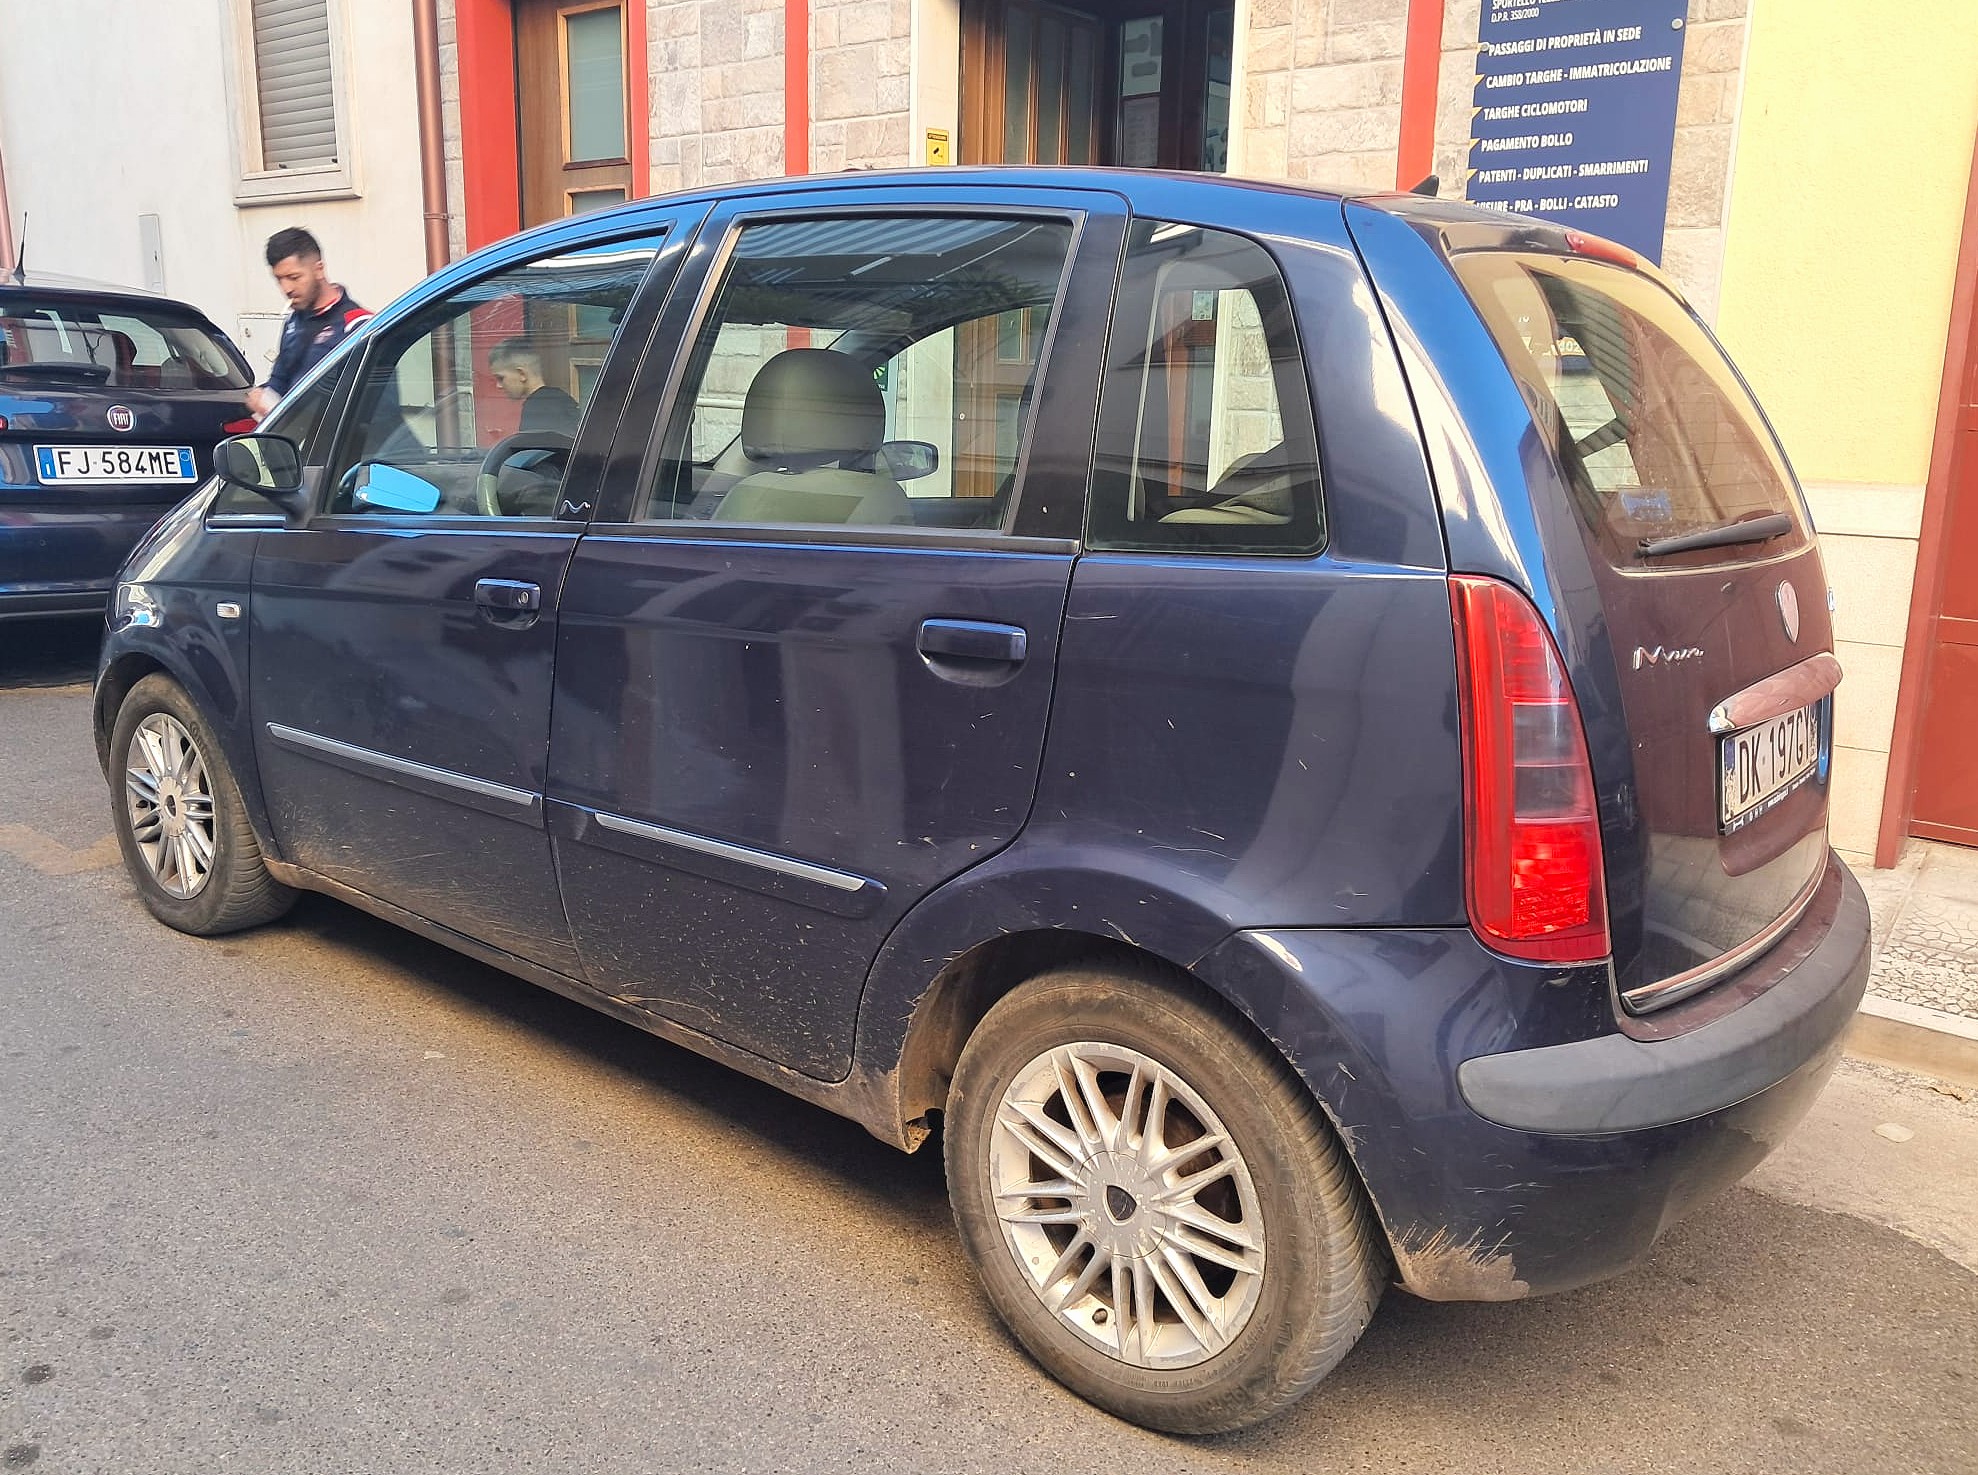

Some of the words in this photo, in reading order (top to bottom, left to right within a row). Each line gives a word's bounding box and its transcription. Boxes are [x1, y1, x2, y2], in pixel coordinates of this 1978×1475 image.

[1488, 39, 1535, 56] PASSAGGI
[1536, 36, 1547, 51] DI
[1548, 28, 1601, 50] PROPRIETÀ
[1603, 30, 1616, 43] IN
[1617, 26, 1642, 42] SEDE
[1486, 74, 1524, 89] CAMBIO
[1525, 71, 1563, 86] TARGHE
[1569, 56, 1672, 81] IMMATRICOLAZIONE
[1483, 104, 1520, 121] TARGHE
[1521, 98, 1588, 118] CICLOMOTORI
[1481, 136, 1539, 152] PAGAMENTO
[1541, 132, 1573, 148] BOLLO
[1479, 169, 1517, 184] PATENTI
[1523, 164, 1572, 181] DUPLICATI
[1578, 159, 1649, 177] SMARRIMENTI
[1514, 199, 1534, 213] PRA
[1539, 197, 1568, 211] BOLLI
[1574, 194, 1619, 209] CATASTO
[113, 412, 129, 426] FIAT
[57, 451, 91, 475] FJ
[101, 451, 178, 475] 584ME
[1739, 732, 1761, 804] DK
